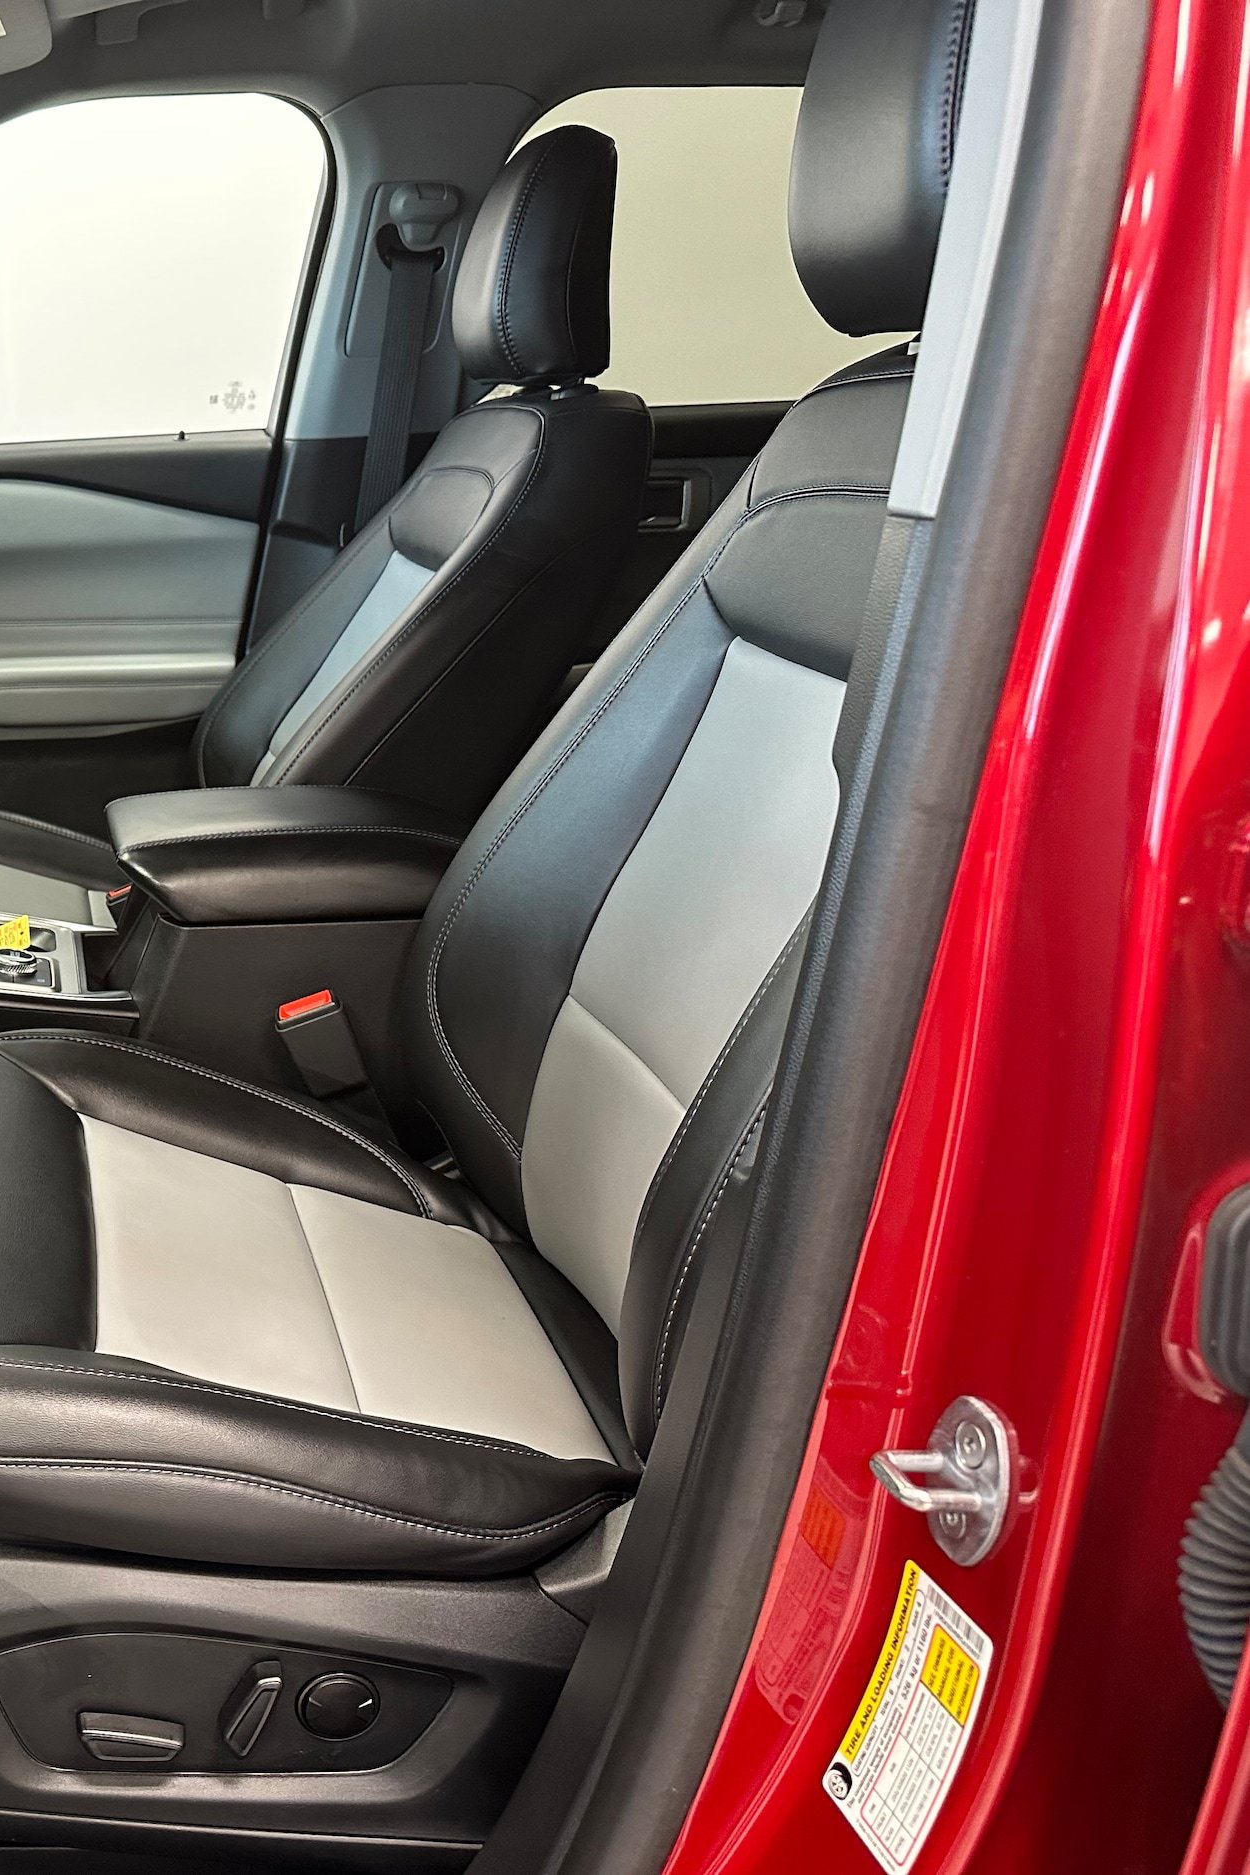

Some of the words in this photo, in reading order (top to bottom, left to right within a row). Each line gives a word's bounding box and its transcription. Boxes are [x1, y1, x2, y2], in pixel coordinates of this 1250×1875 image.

[845, 1729, 861, 1756] TIRE
[860, 1704, 873, 1728] AND
[870, 1652, 893, 1703] LOADING
[891, 1569, 917, 1650] INFORMATION
